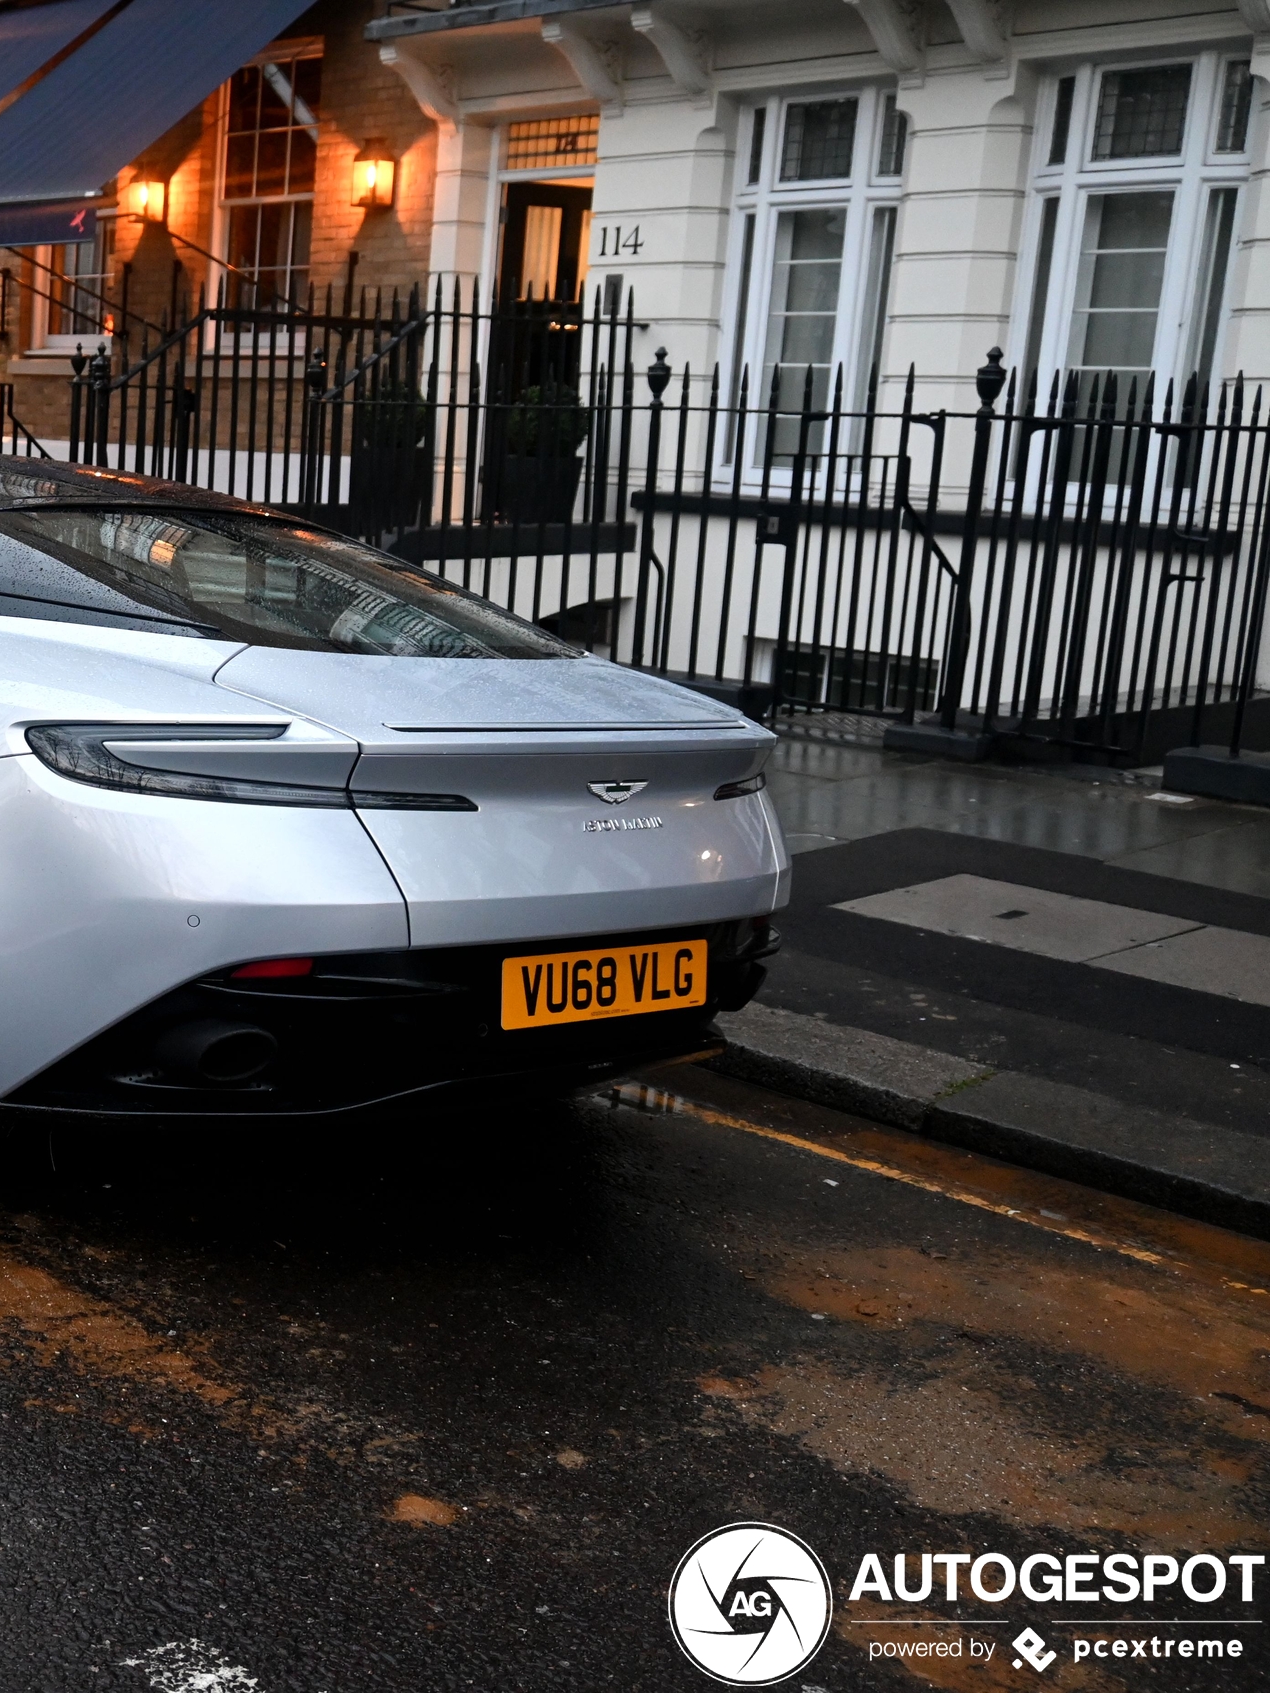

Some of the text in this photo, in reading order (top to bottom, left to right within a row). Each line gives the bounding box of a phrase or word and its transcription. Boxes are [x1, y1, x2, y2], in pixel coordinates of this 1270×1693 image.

[599, 224, 645, 257] 114
[521, 948, 693, 1016] VU68 VLG
